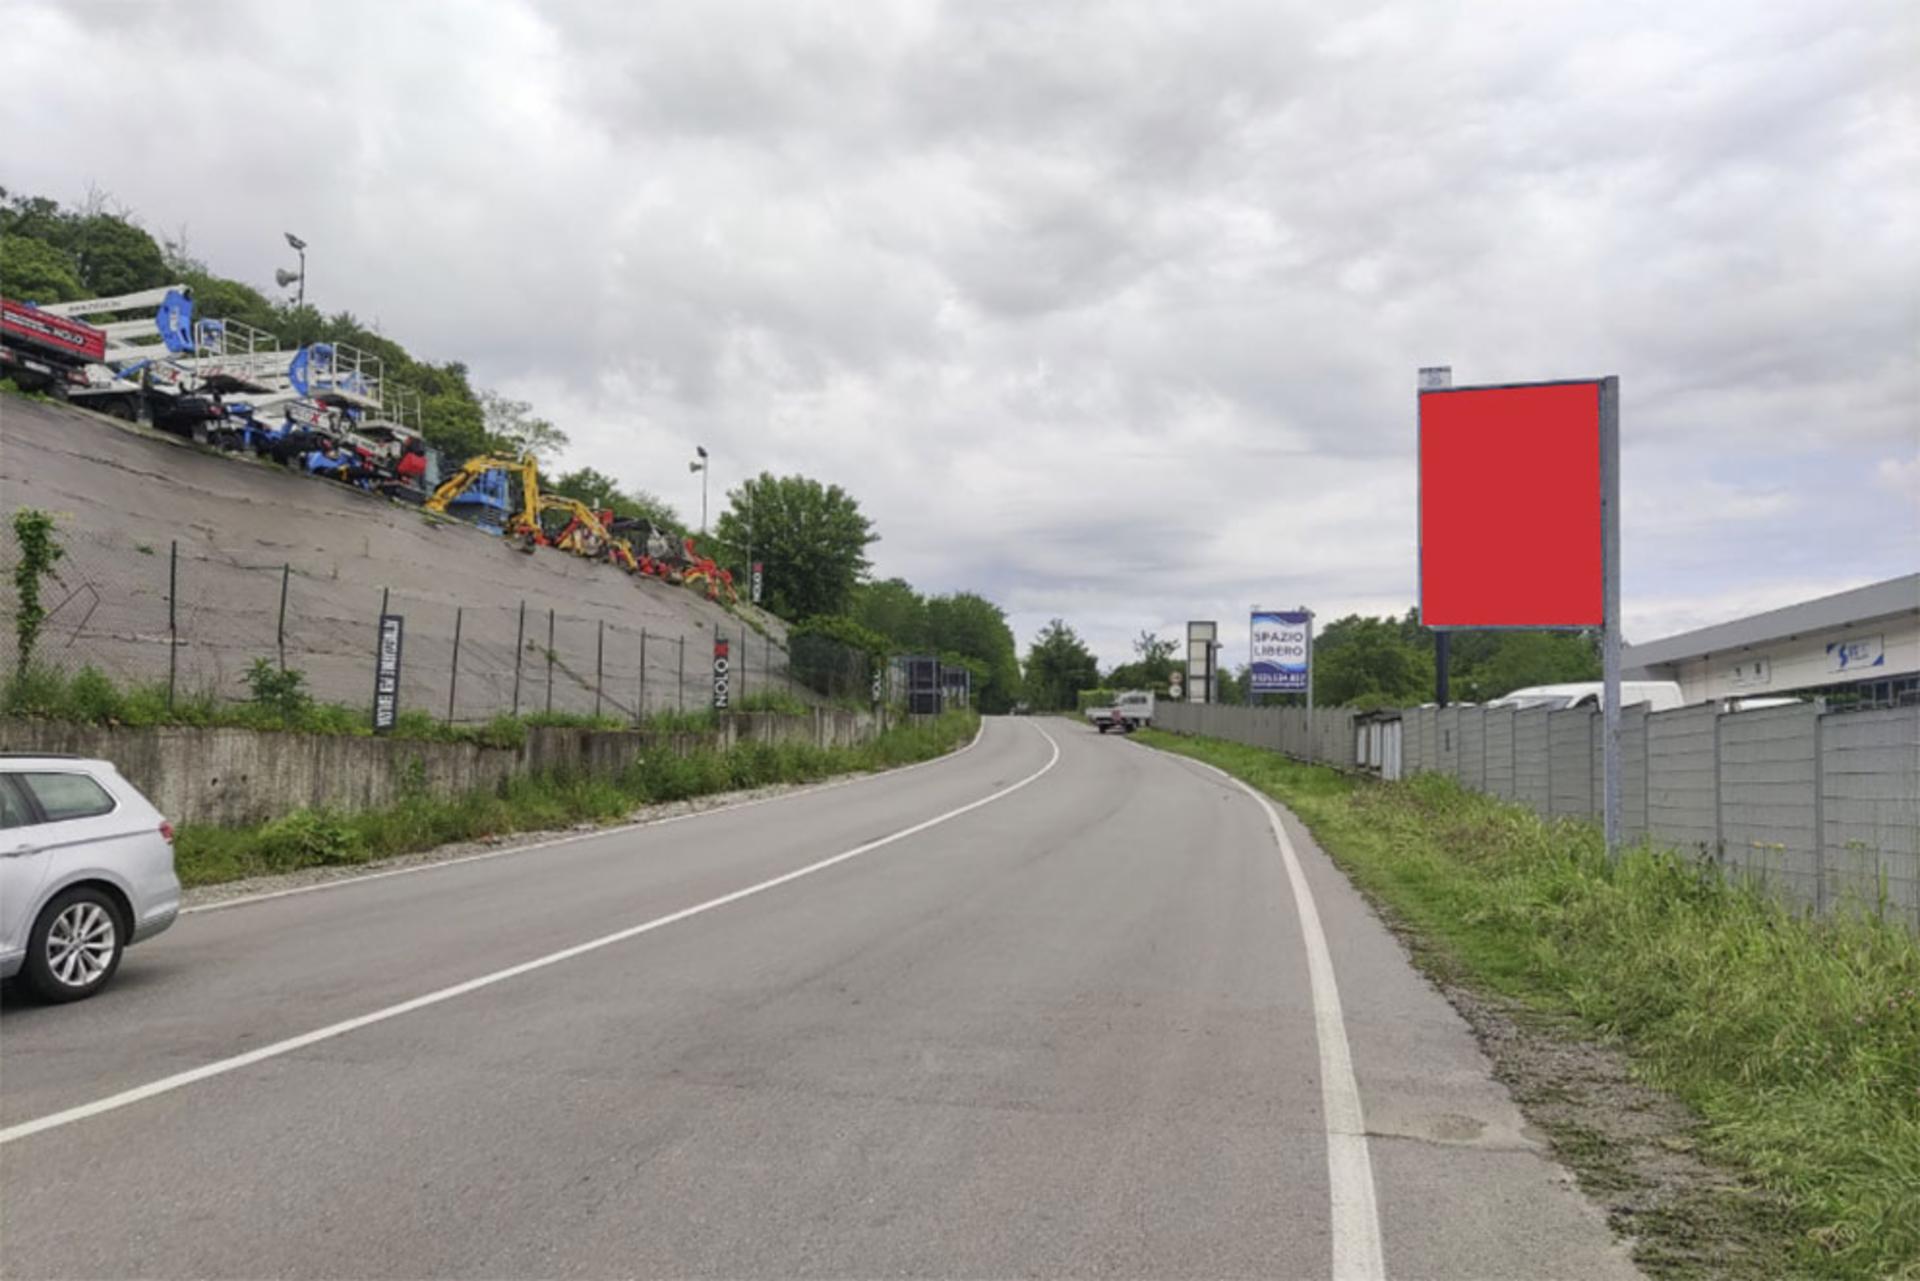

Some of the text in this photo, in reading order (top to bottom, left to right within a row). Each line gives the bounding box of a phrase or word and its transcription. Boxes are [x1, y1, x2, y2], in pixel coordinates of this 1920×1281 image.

[1254, 631, 1304, 643] SPAZIO
[1254, 645, 1304, 657] LIBERO
[714, 658, 729, 708] NOLO
